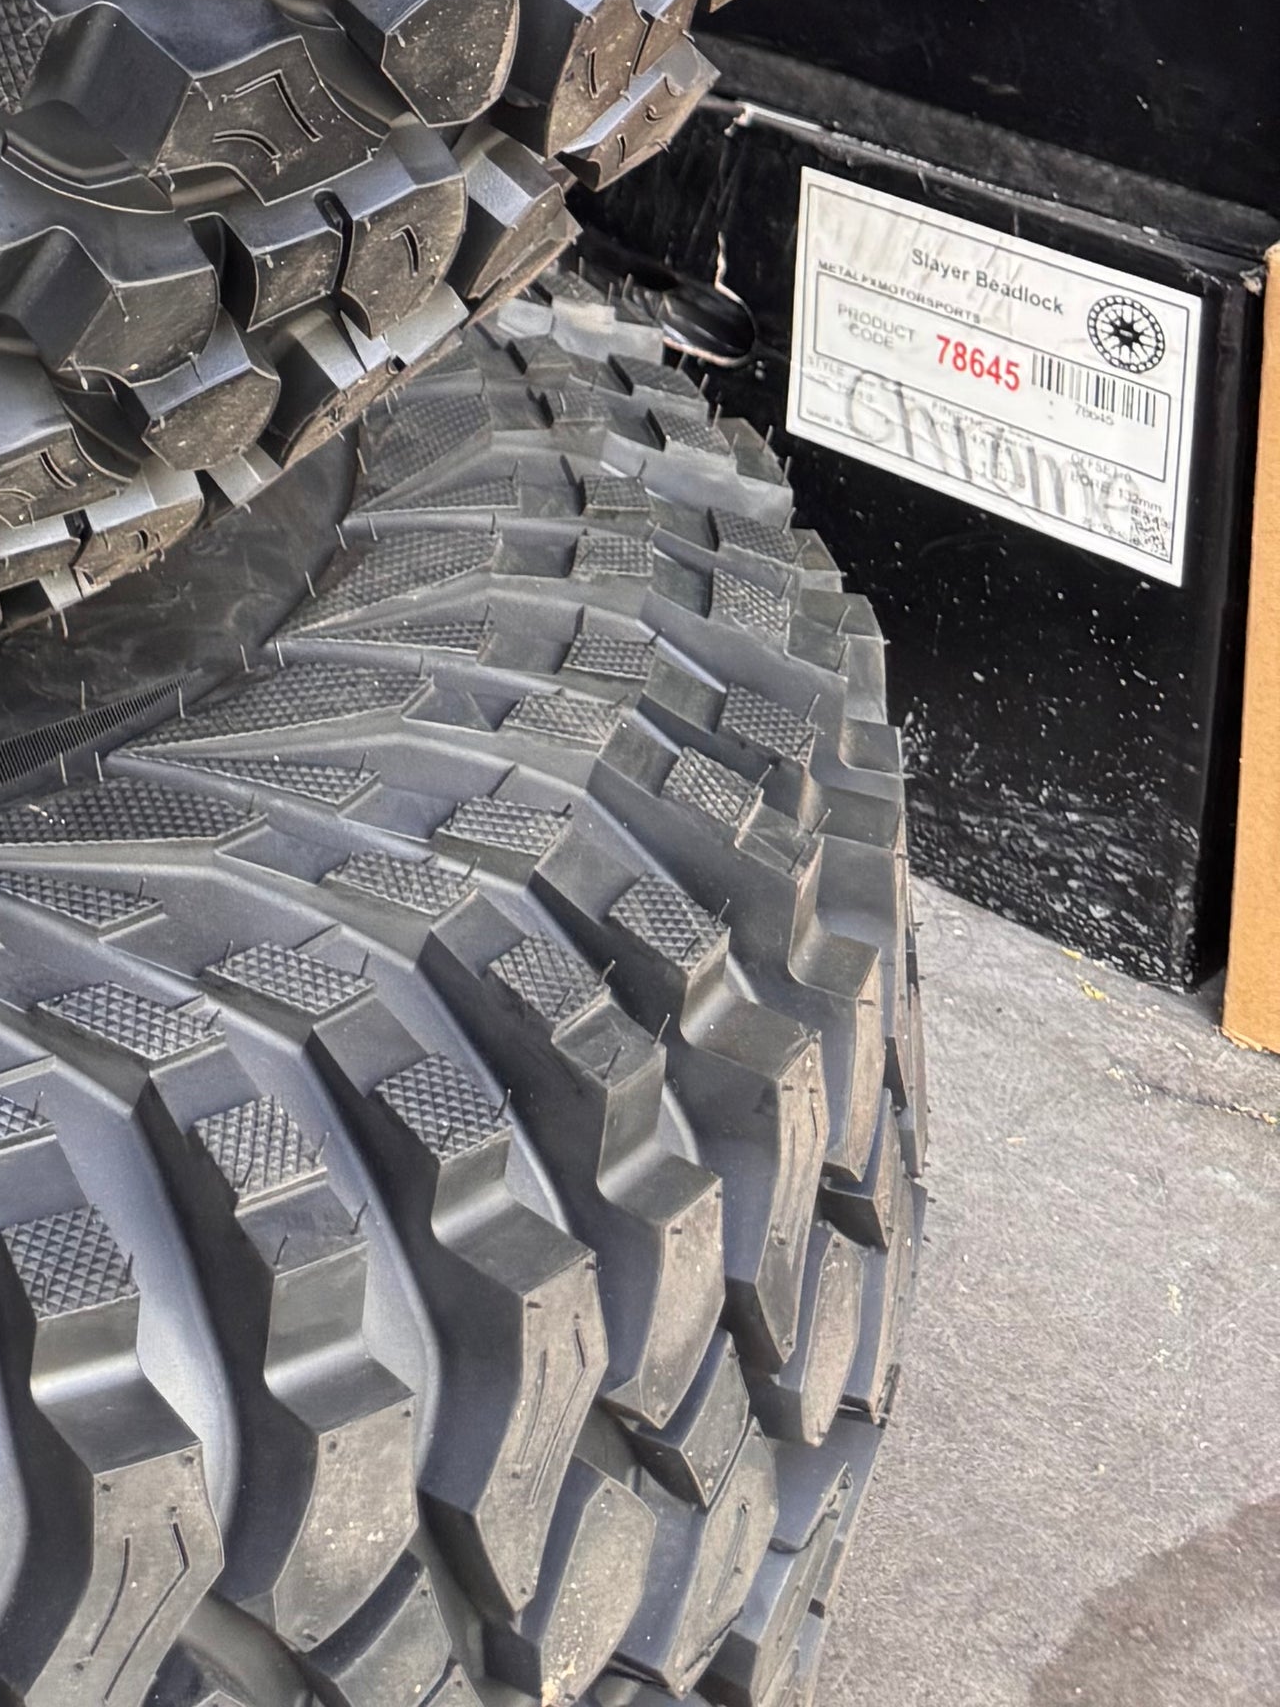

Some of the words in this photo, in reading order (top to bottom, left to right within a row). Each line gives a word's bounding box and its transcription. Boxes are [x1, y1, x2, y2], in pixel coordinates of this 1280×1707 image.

[910, 248, 970, 285] Slayer
[975, 269, 1065, 316] Beadlock
[837, 302, 916, 345] PRODUCT
[848, 323, 895, 350] CODE
[935, 333, 1021, 393] 78645
